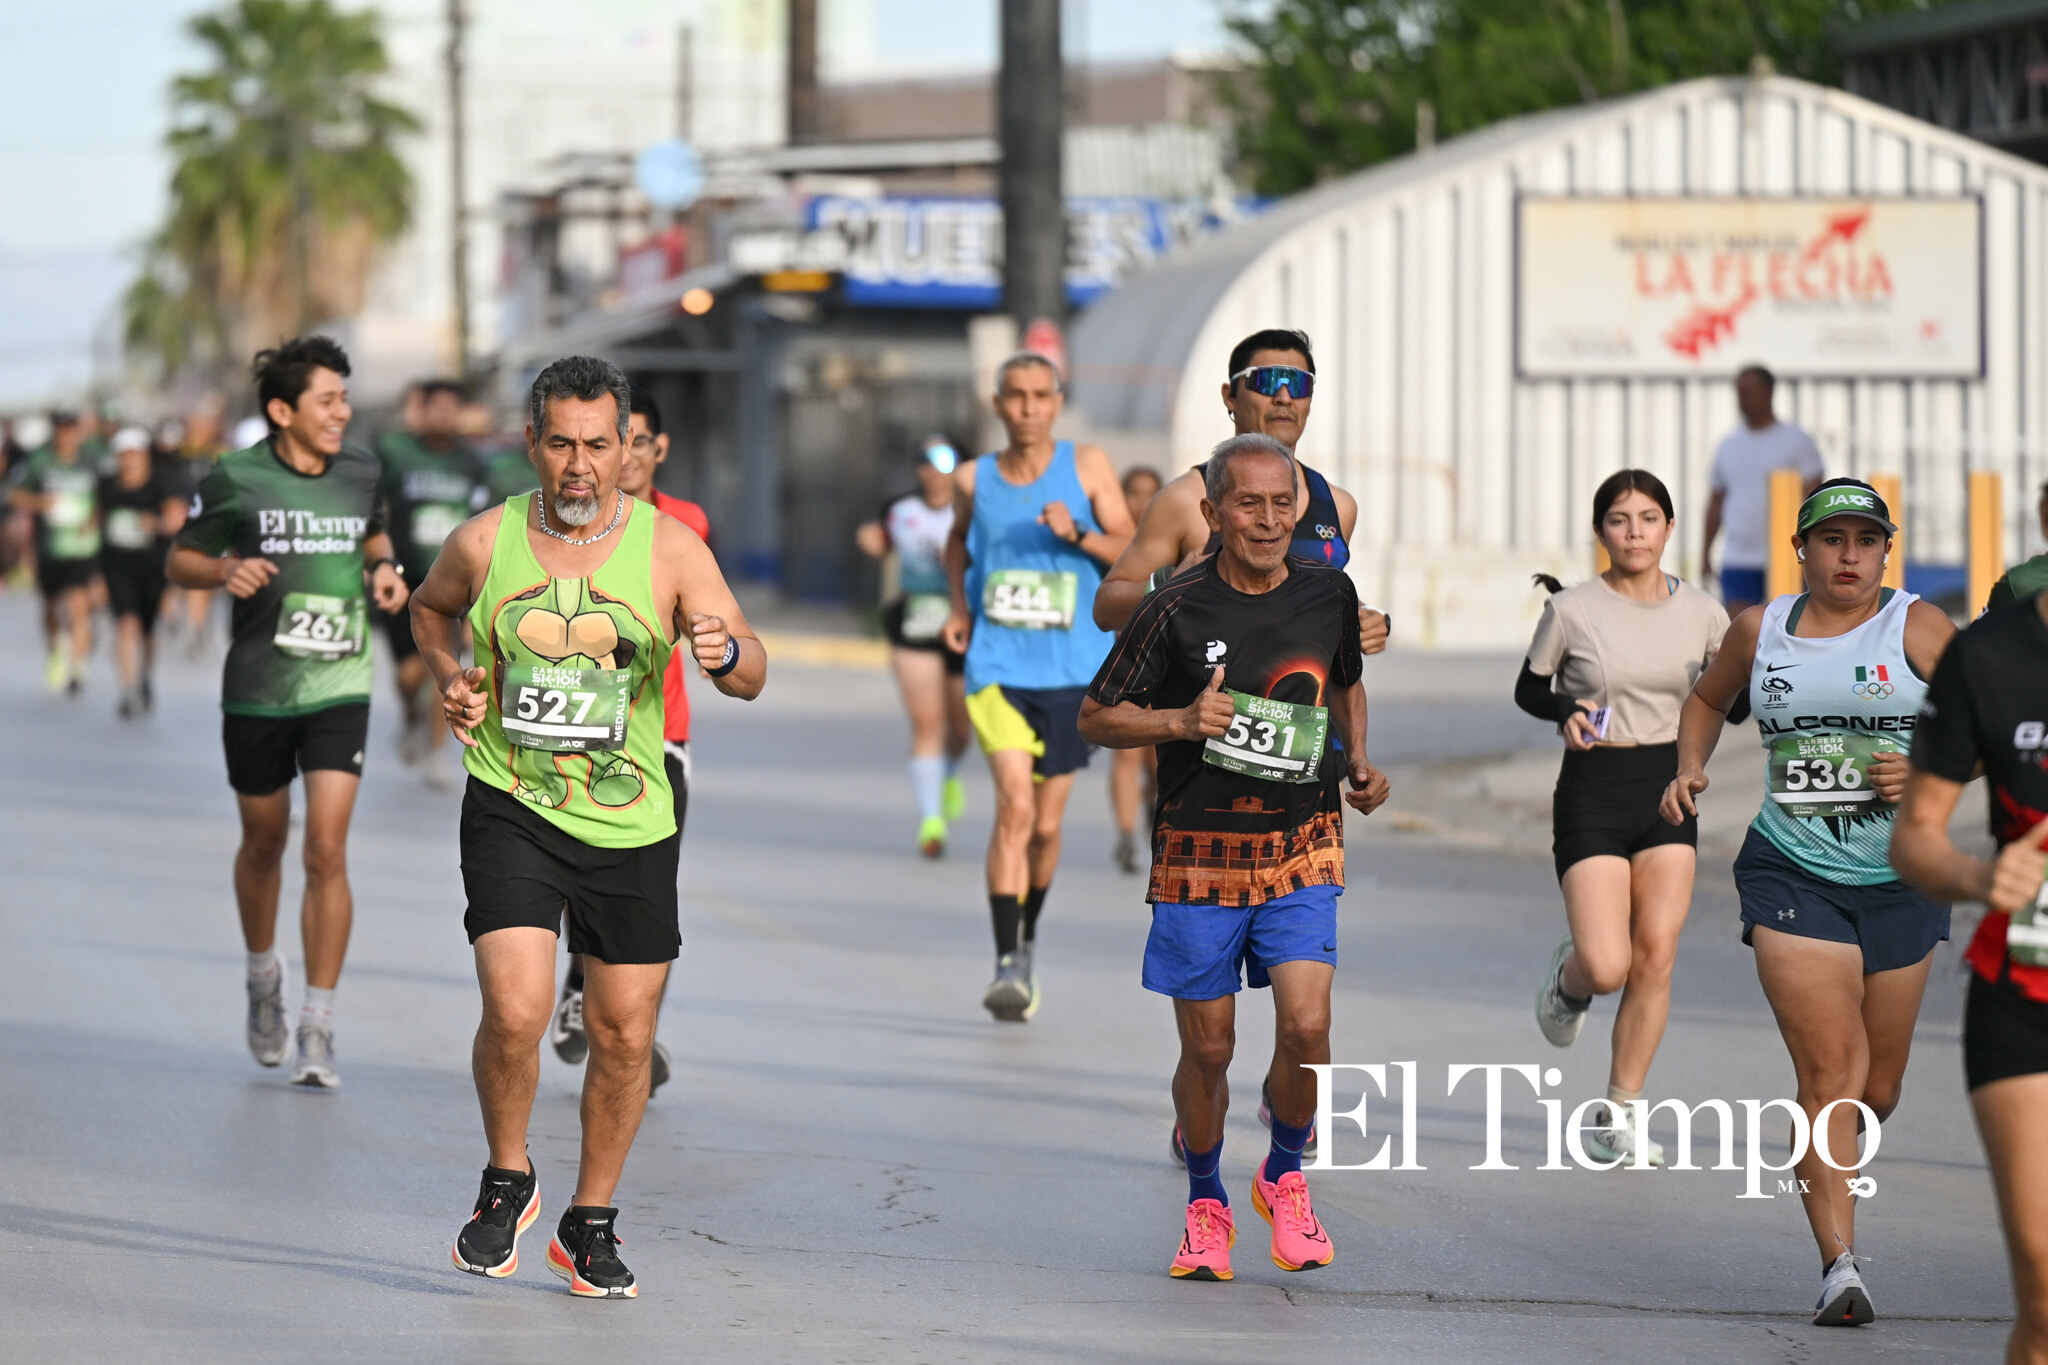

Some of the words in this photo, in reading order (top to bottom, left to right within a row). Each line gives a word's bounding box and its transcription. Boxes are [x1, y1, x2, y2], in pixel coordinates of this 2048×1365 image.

[258, 510, 287, 535] El
[260, 536, 290, 554] de
[292, 536, 356, 554] todos
[993, 585, 1050, 609] 544
[289, 610, 348, 642] 267
[532, 666, 582, 676] CARRERA
[616, 674, 630, 683] 527
[517, 686, 598, 725] 527
[1250, 697, 1294, 711] CARRERA
[1767, 694, 1782, 703] JR
[613, 687, 627, 741] MEDALLA
[1315, 712, 1326, 720] 531
[1224, 713, 1296, 757] 531
[1797, 737, 1844, 745] CARRERA
[1305, 725, 1324, 776] MEDALLA
[1786, 757, 1862, 791] 536
